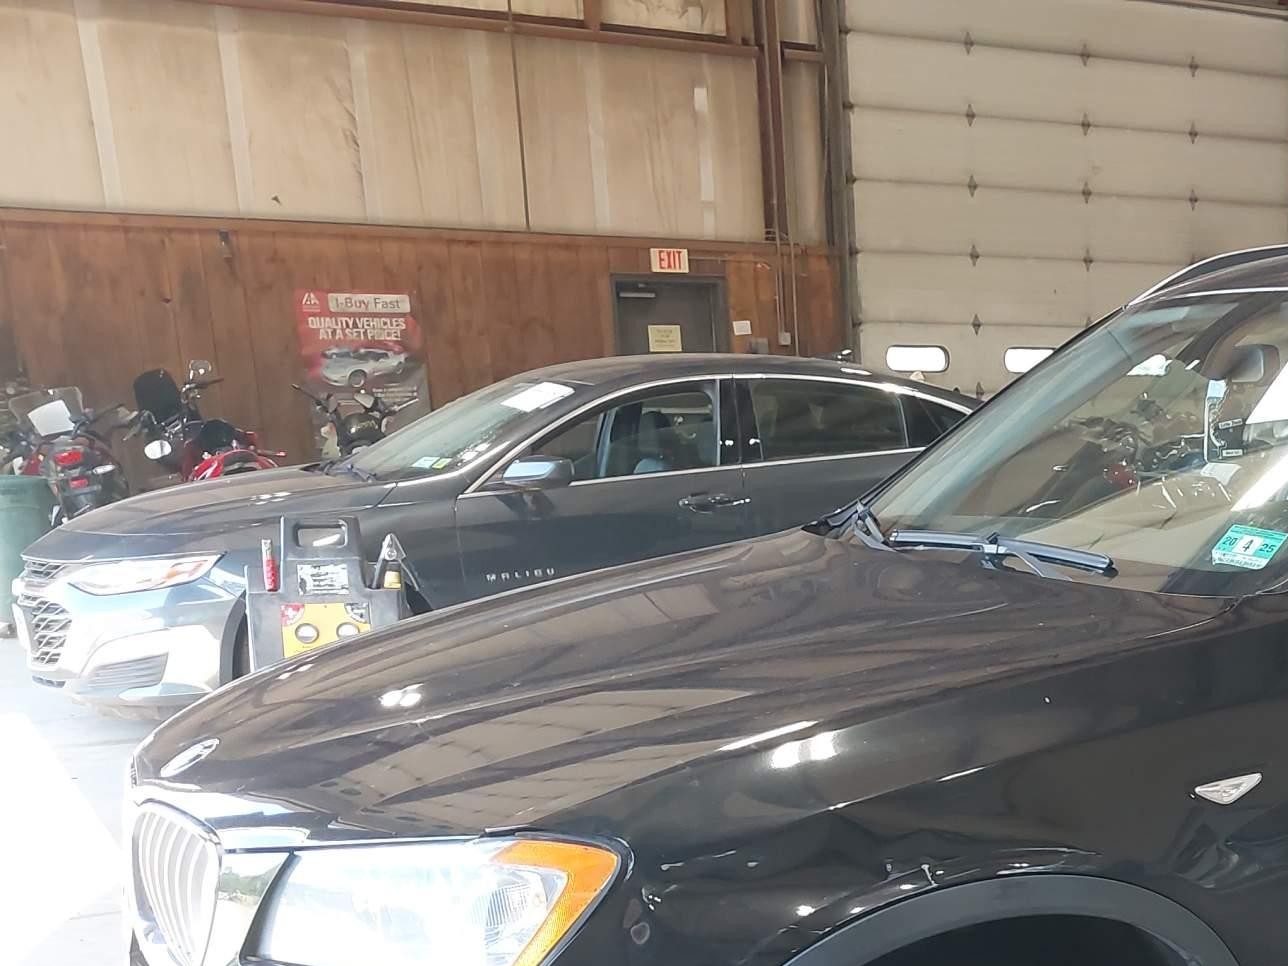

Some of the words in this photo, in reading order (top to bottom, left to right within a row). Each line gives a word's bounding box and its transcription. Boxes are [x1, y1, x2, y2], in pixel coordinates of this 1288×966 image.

[659, 250, 682, 270] EXIT
[335, 297, 369, 311] I-Buy
[374, 297, 401, 310] Fast
[308, 316, 354, 329] QUALITY
[355, 317, 406, 330] VEHICLES
[319, 328, 333, 341] AT
[335, 329, 344, 340] A
[345, 329, 366, 341] SET
[1222, 536, 1239, 547] 20
[1242, 539, 1255, 553] 4
[1259, 543, 1277, 554] 25
[485, 567, 555, 583] MALIBU
